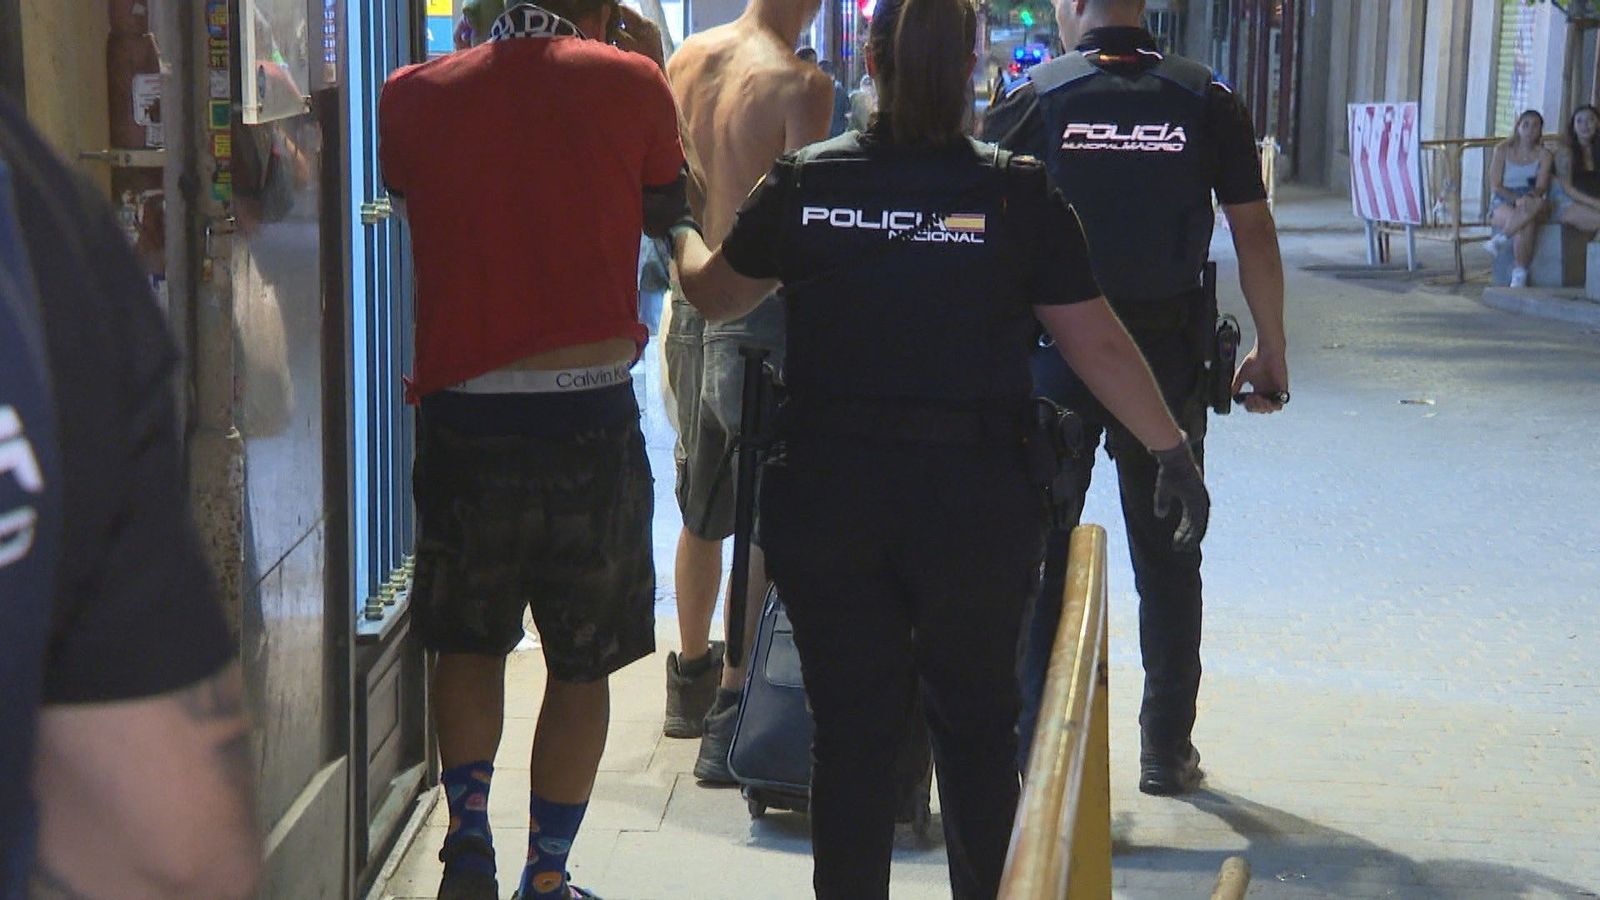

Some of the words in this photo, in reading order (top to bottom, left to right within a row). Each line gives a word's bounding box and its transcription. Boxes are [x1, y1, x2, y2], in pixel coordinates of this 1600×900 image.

[1062, 122, 1187, 142] POLICÍA
[888, 230, 985, 243] NCIONAL
[556, 369, 613, 389] Calvin
